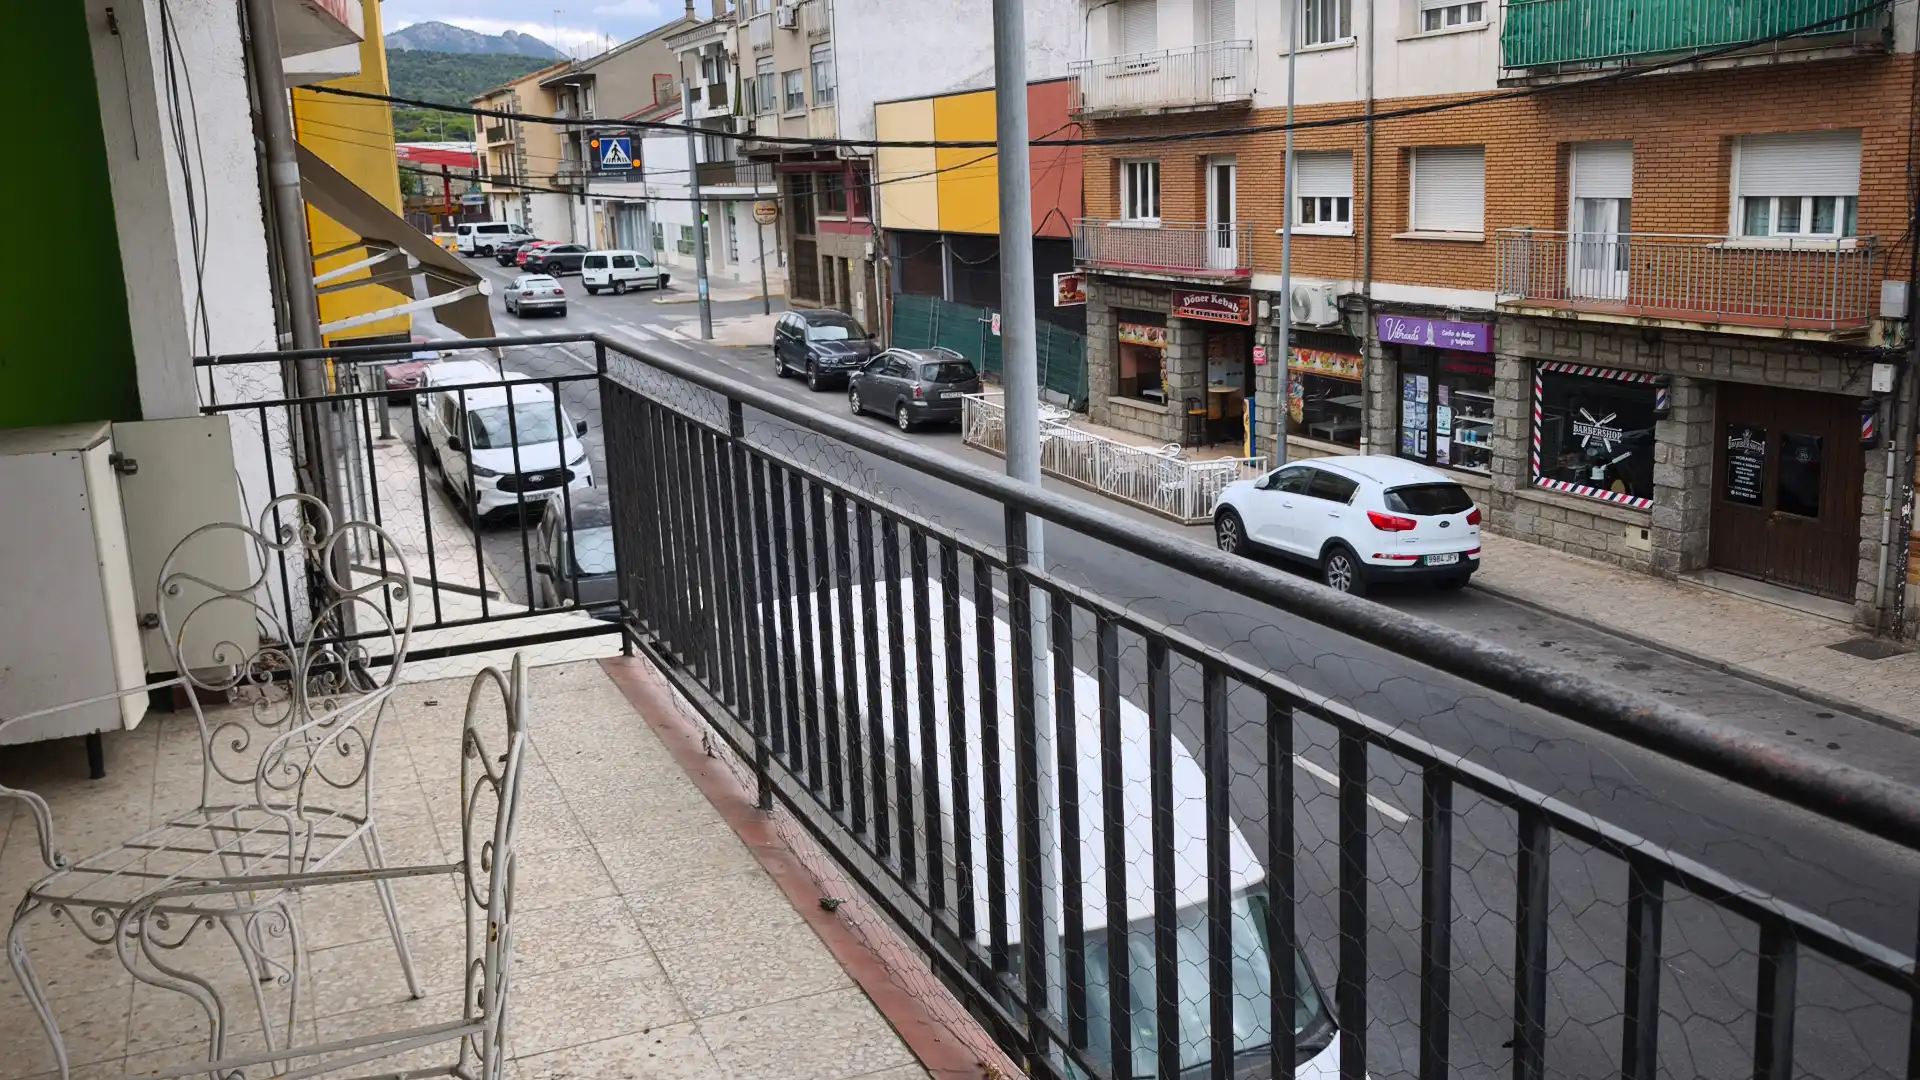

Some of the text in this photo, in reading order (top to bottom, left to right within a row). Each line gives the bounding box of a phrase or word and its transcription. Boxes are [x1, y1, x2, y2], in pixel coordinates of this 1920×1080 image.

[1183, 294, 1239, 313] Döner Kebab
[1573, 423, 1622, 440] BARBERSHOP
